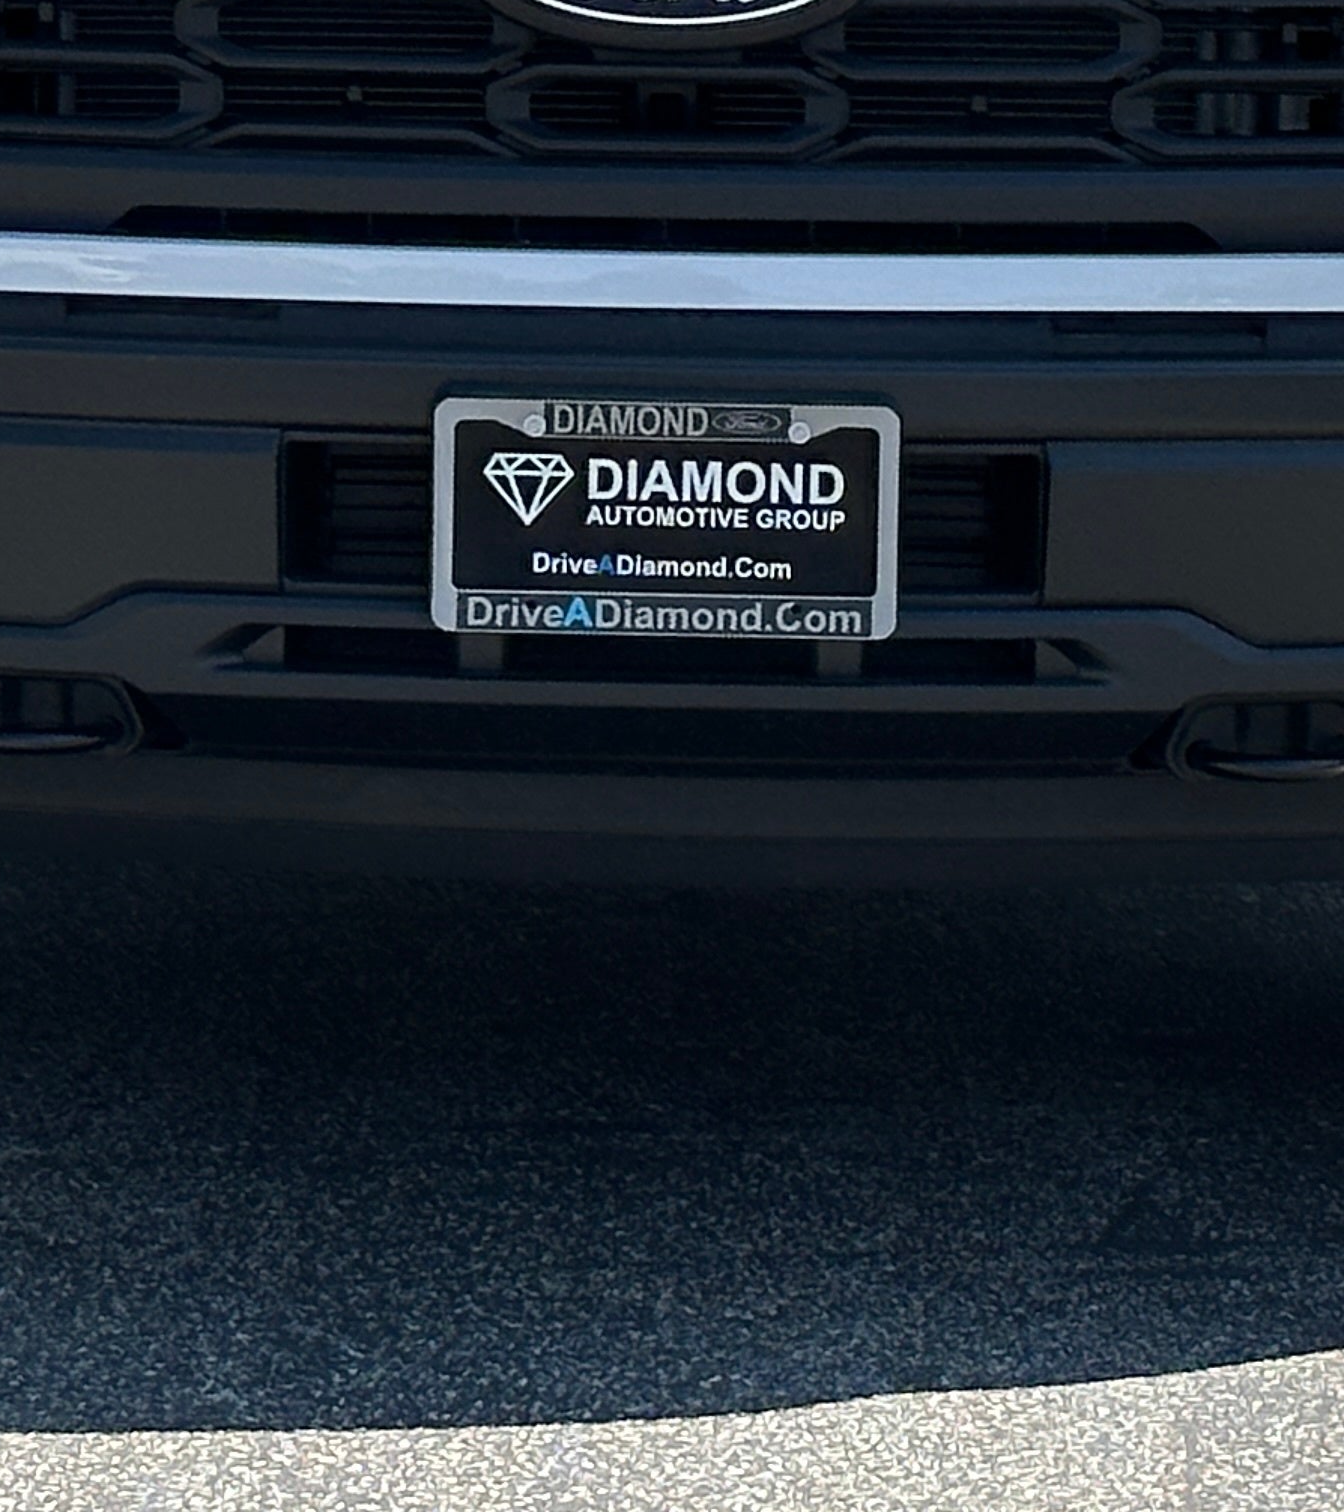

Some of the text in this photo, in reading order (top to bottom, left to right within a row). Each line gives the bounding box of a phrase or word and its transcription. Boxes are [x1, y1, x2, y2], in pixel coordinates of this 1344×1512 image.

[554, 403, 709, 437] DIAMOND
[587, 457, 846, 506] DIAMOND
[585, 506, 846, 532] AUTOMOTIVE GROUP
[532, 551, 792, 580] DriveADiamond.Com
[466, 596, 862, 634] DriveADiamond.Com
